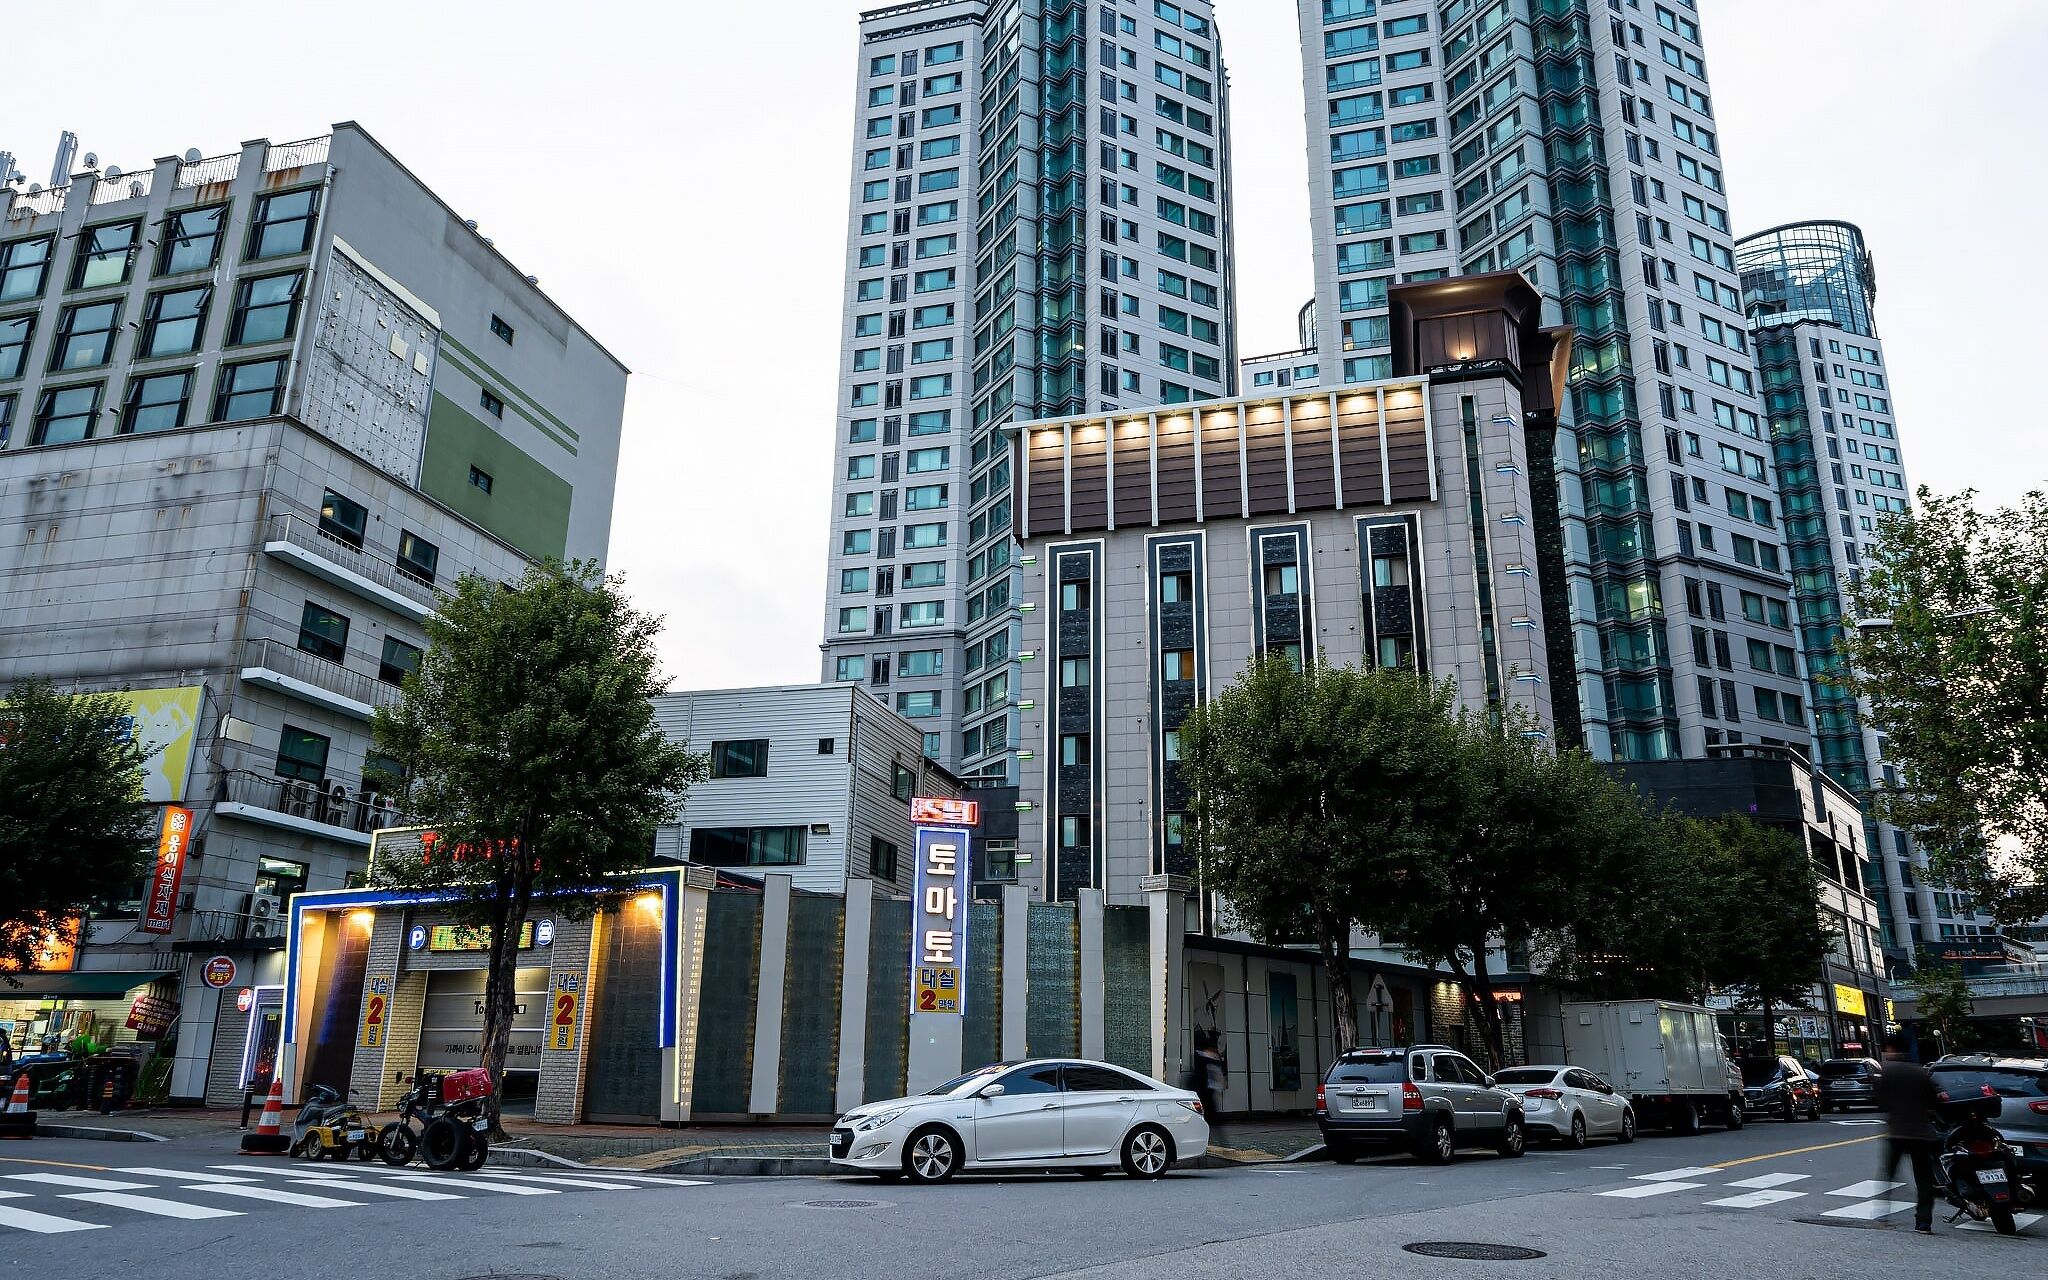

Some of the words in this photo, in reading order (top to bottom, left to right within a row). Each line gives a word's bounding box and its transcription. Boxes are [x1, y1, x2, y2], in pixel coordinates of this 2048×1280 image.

[923, 843, 957, 963] 토마토
[411, 929, 424, 948] P
[370, 977, 389, 994] 대실
[557, 973, 579, 992] 대실
[921, 969, 955, 989] 대실
[466, 1044, 481, 1055] 오시
